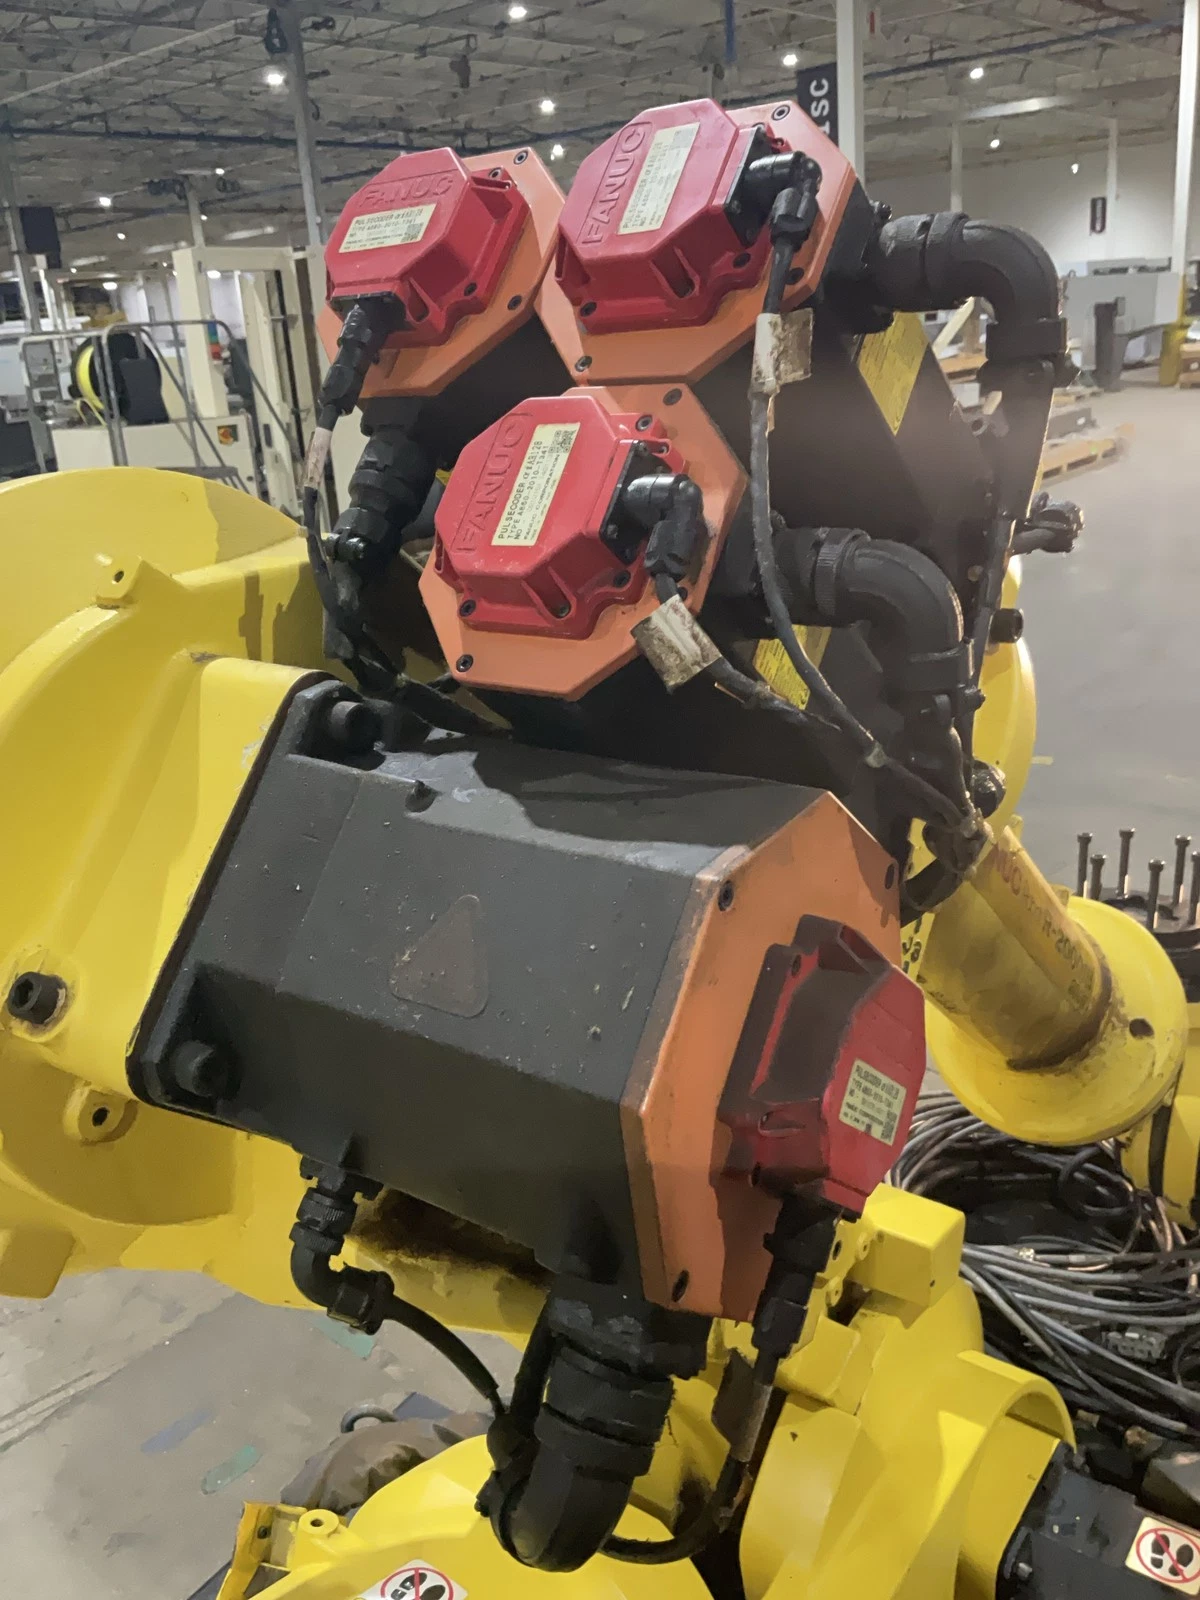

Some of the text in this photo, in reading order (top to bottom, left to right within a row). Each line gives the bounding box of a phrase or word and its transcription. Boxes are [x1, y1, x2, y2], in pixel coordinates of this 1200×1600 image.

[360, 174, 454, 208] FANUC
[580, 126, 646, 245] FANUC
[456, 421, 525, 552] FANUC
[497, 482, 526, 540] PULSECODER
[507, 519, 521, 540] TYPE
